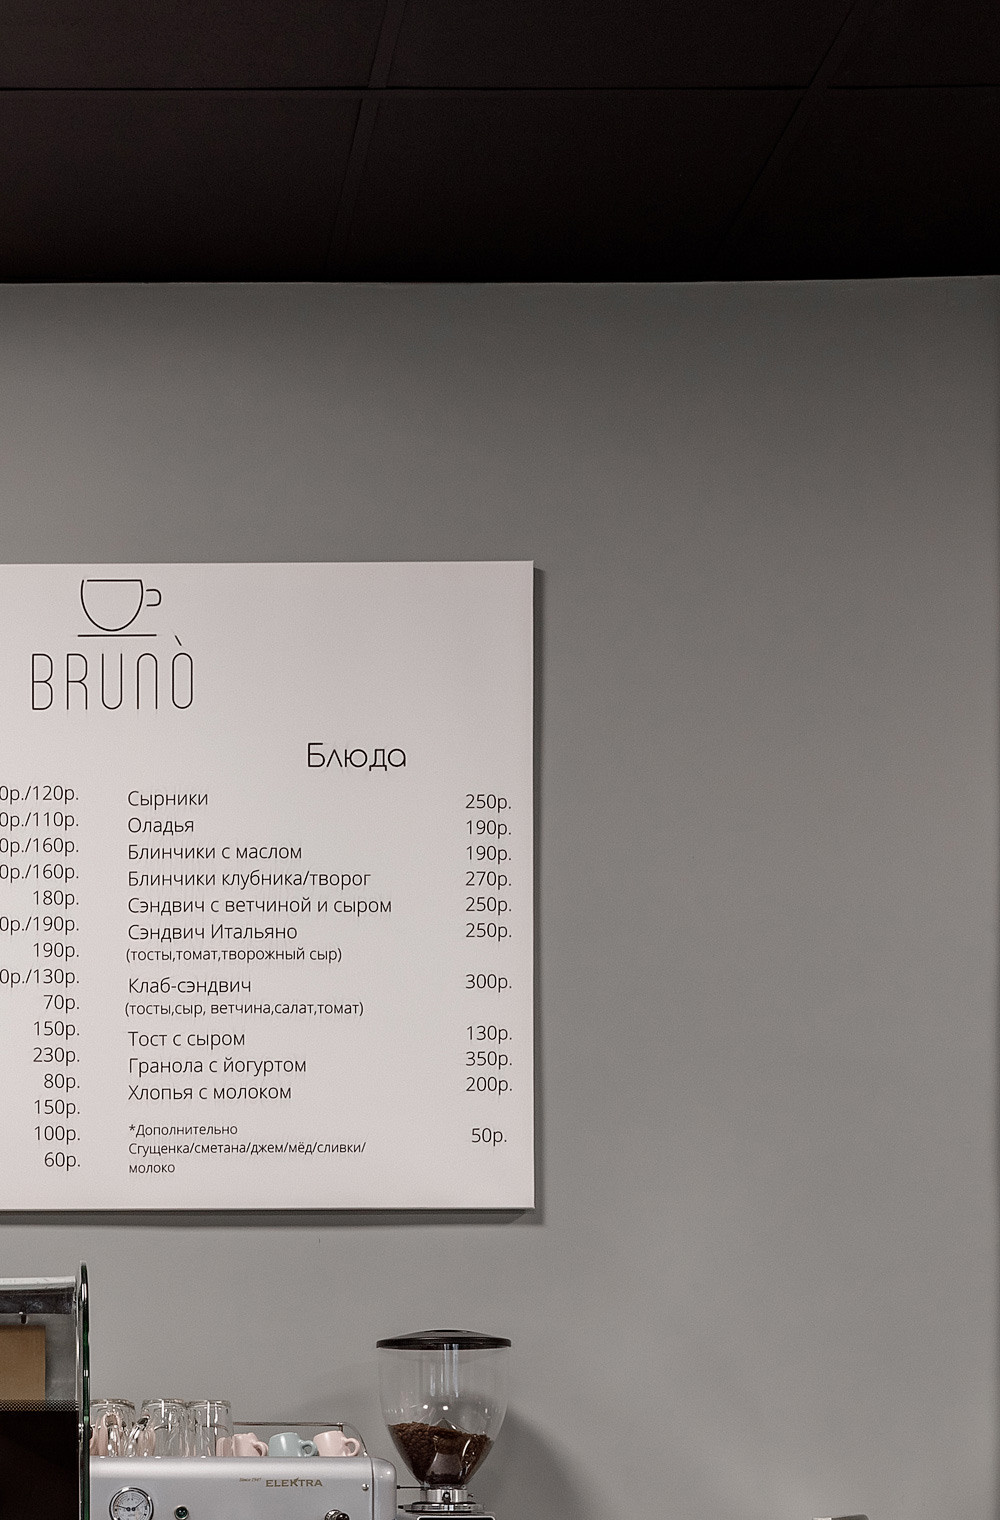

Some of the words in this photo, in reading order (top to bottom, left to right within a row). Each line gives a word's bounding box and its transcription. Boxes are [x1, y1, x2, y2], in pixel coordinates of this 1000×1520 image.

[307, 742, 407, 772] Блюда
[127, 790, 209, 812] Сырники
[464, 793, 512, 814] 250р.
[127, 816, 195, 837] Оладья
[465, 819, 512, 840] 190р.
[128, 843, 216, 860] Блинчики
[221, 846, 231, 860] с
[235, 846, 302, 861] маслом
[466, 844, 512, 866] 190р.
[128, 870, 216, 889] Блинчики
[221, 868, 372, 892] клубника/творог
[464, 869, 512, 891] 270р.
[32, 889, 80, 912] 180р.
[127, 897, 205, 917] Сэндвич
[210, 899, 220, 914] с
[224, 896, 312, 913] ветчиной
[317, 900, 328, 913] и
[333, 895, 392, 918] сыром
[465, 896, 512, 917] 250р.
[127, 922, 205, 944] Сэндвич
[210, 922, 298, 942] Итальяно
[465, 921, 512, 943] 250р.
[32, 941, 80, 963] 190р.
[309, 947, 343, 965] сыр)
[128, 976, 252, 997] Клаб-сэндвич
[465, 973, 513, 994] 300р.
[42, 993, 80, 1015] 70р.
[33, 1020, 80, 1041] 150р.
[126, 1030, 168, 1048] Тост
[172, 1033, 182, 1047] с
[186, 1033, 246, 1051] сыром
[466, 1024, 513, 1045] 130р.
[32, 1046, 81, 1070] 230р.
[129, 1057, 204, 1079] Гранола
[208, 1060, 218, 1074] с
[223, 1056, 307, 1078] йогуртом
[465, 1050, 513, 1071] 350р.
[43, 1072, 81, 1094] 80р.
[127, 1082, 193, 1101] Хлопья
[198, 1086, 208, 1101] с
[213, 1086, 292, 1100] молоком
[465, 1075, 513, 1097] 200р.
[33, 1098, 81, 1120] 150р.
[34, 1124, 81, 1147] 100р.
[471, 1127, 508, 1148] 50р.
[44, 1151, 81, 1172] 60р.
[128, 1163, 176, 1174] молоко
[265, 1478, 323, 1487] ELEKTRA
